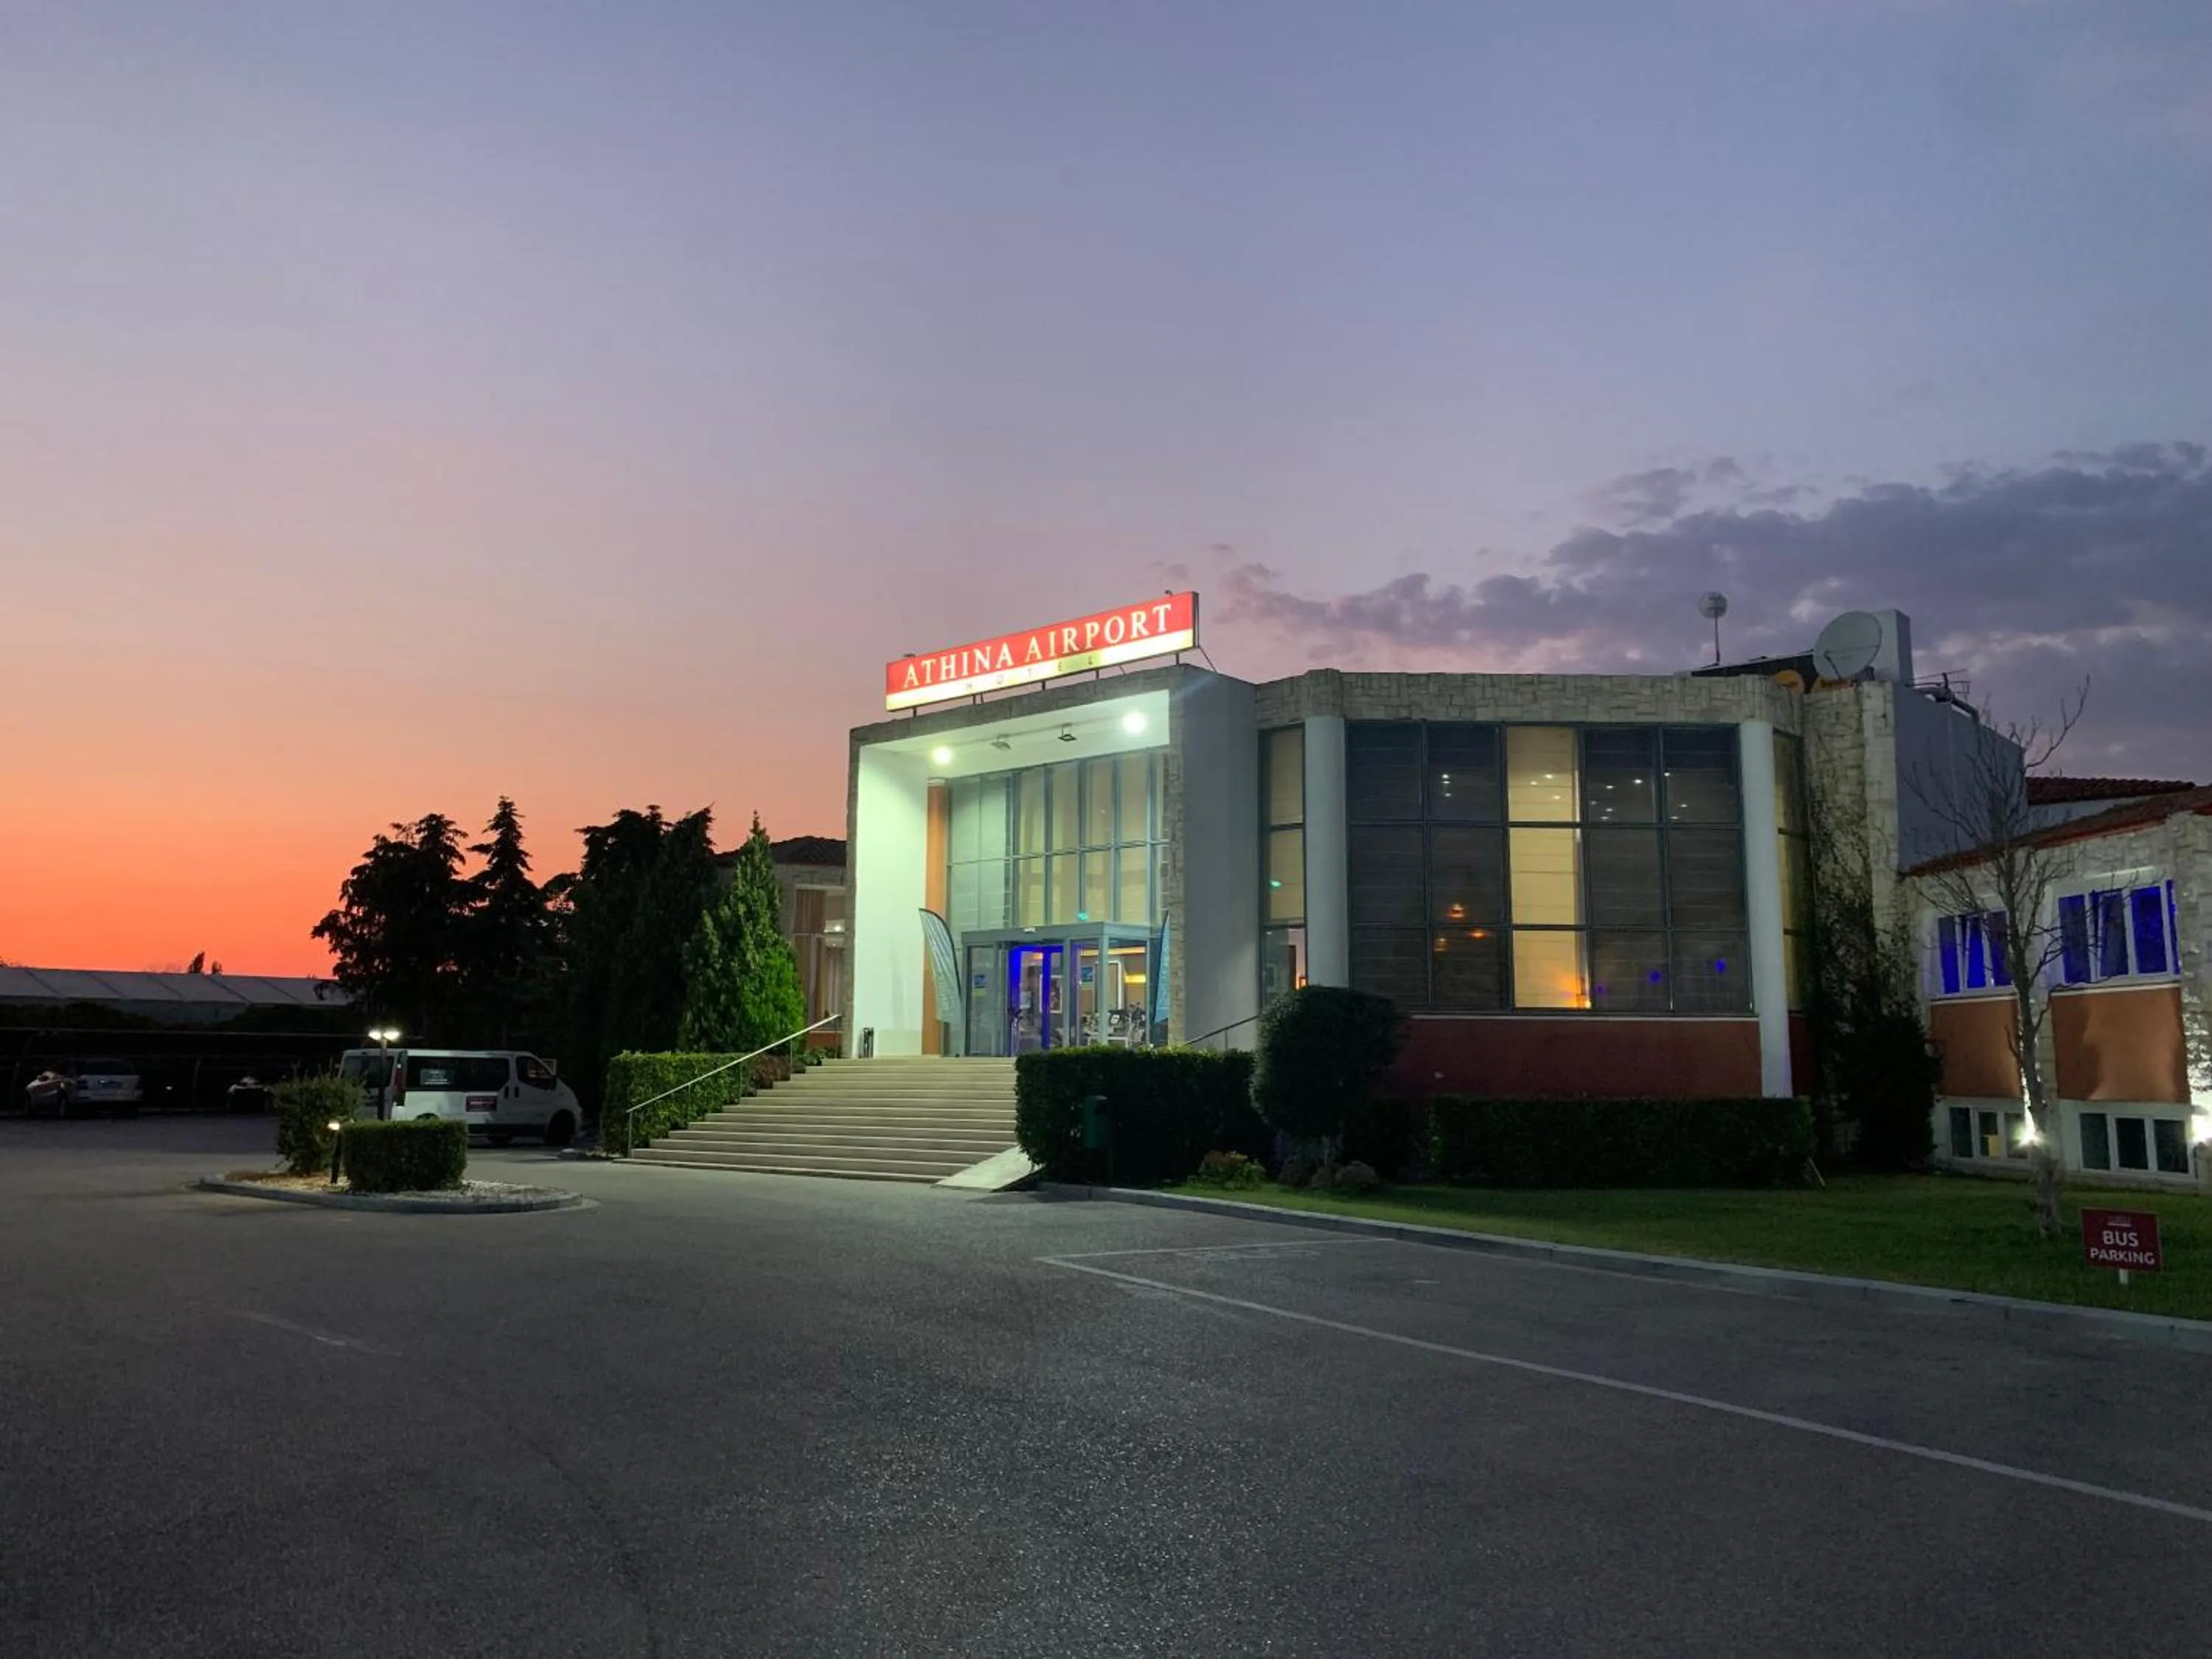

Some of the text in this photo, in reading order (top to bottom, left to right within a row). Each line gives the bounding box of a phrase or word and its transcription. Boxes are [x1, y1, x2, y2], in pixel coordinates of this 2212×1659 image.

[902, 603, 1172, 689] ATHINA AIRPORT
[2102, 1230, 2139, 1247] BUS
[2090, 1247, 2155, 1265] PARKING
